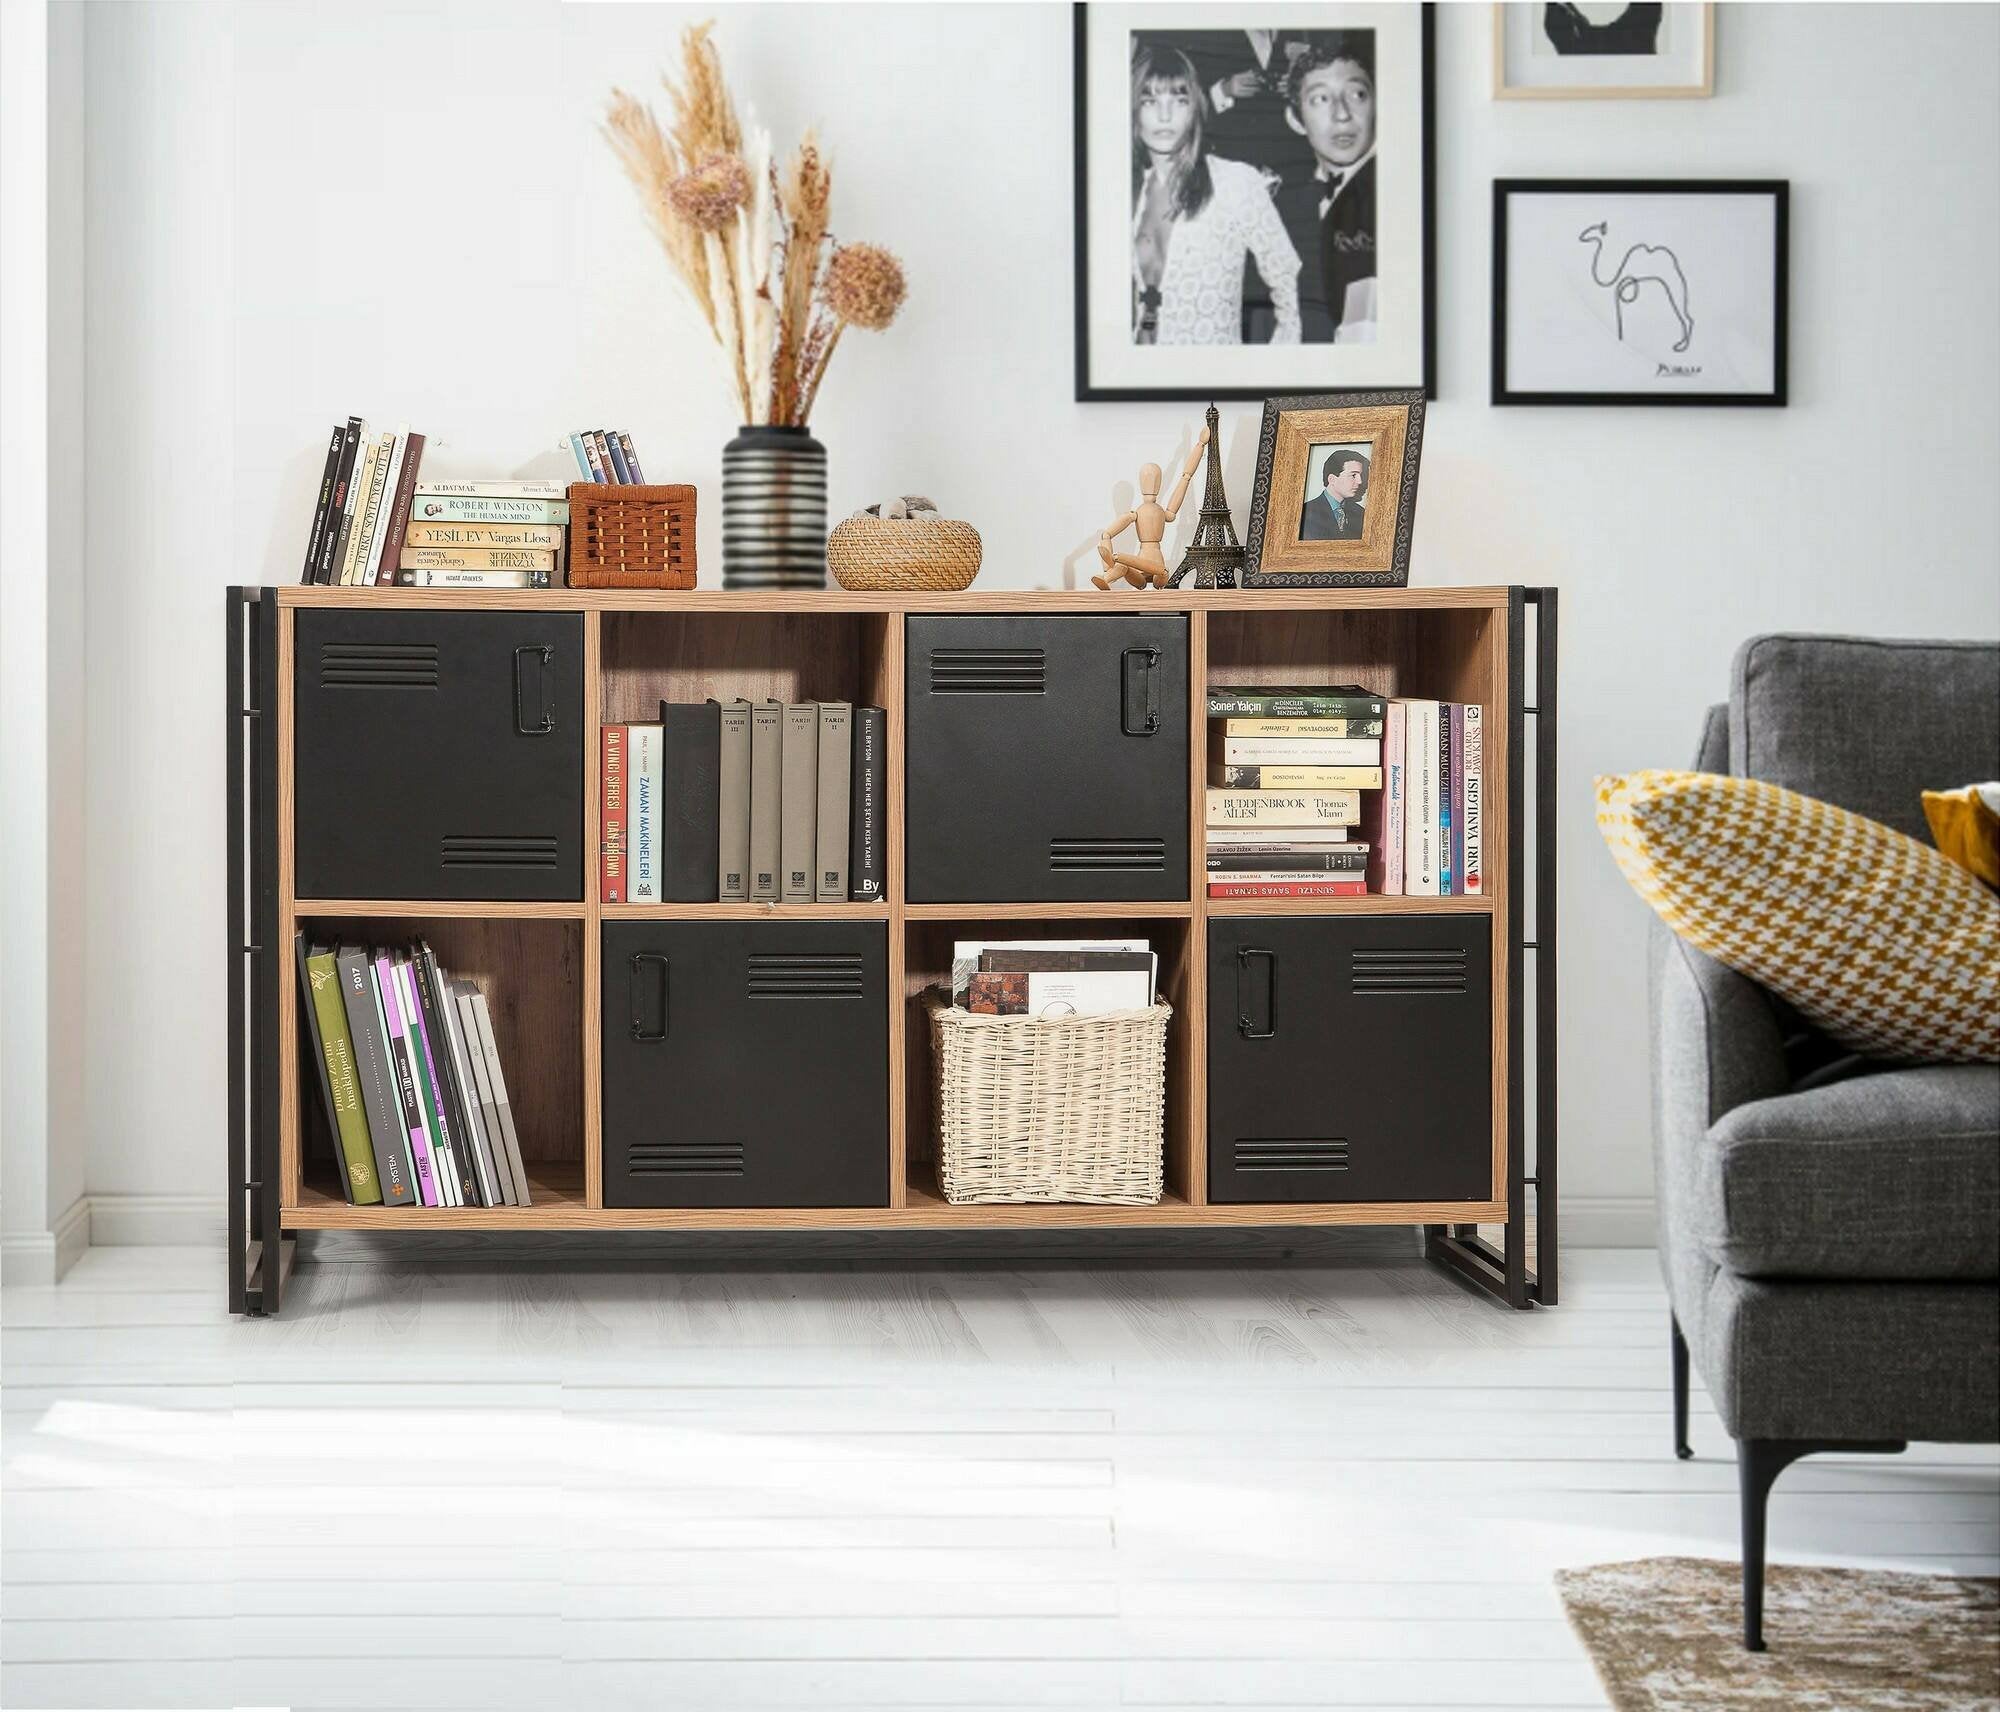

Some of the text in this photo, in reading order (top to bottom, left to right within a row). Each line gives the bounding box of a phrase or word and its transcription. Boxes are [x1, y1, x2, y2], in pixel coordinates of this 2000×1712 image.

[376, 441, 391, 477] OTLAR
[334, 481, 346, 508] manifesto
[432, 484, 476, 493] ALDATMAK
[399, 493, 407, 507] Yere
[449, 500, 544, 512] ROBERT WINSTON
[479, 512, 508, 520] HUMAN
[510, 513, 531, 521] MIND
[426, 529, 484, 543] YEŞİL EV
[488, 531, 551, 545] Vargas Llosa
[322, 531, 334, 569] george monbiot
[1210, 700, 1262, 714] Soner Yalçın
[606, 732, 620, 744] DA
[1464, 731, 1473, 770] RICHARD
[1471, 726, 1482, 775] DAWKINS
[604, 775, 622, 809] ŞİFRESİ
[638, 776, 650, 813] ZAMAN
[1223, 798, 1306, 809] BUDDENBROOK
[1223, 807, 1257, 818] AİLESİ
[1314, 798, 1348, 808] Thomas
[1317, 808, 1343, 818] Mann
[605, 820, 619, 839] DAN
[1465, 777, 1479, 884] TANRI YANILGISI
[638, 815, 652, 879] MAKİNELERİ
[605, 841, 619, 877] BROWN
[863, 879, 880, 893] By
[351, 967, 362, 989] 2017
[324, 1040, 337, 1075] Zeytin
[334, 1039, 356, 1109] Ansiklopedisi
[402, 1076, 412, 1090] 100
[388, 1154, 399, 1183] SYSTEM
